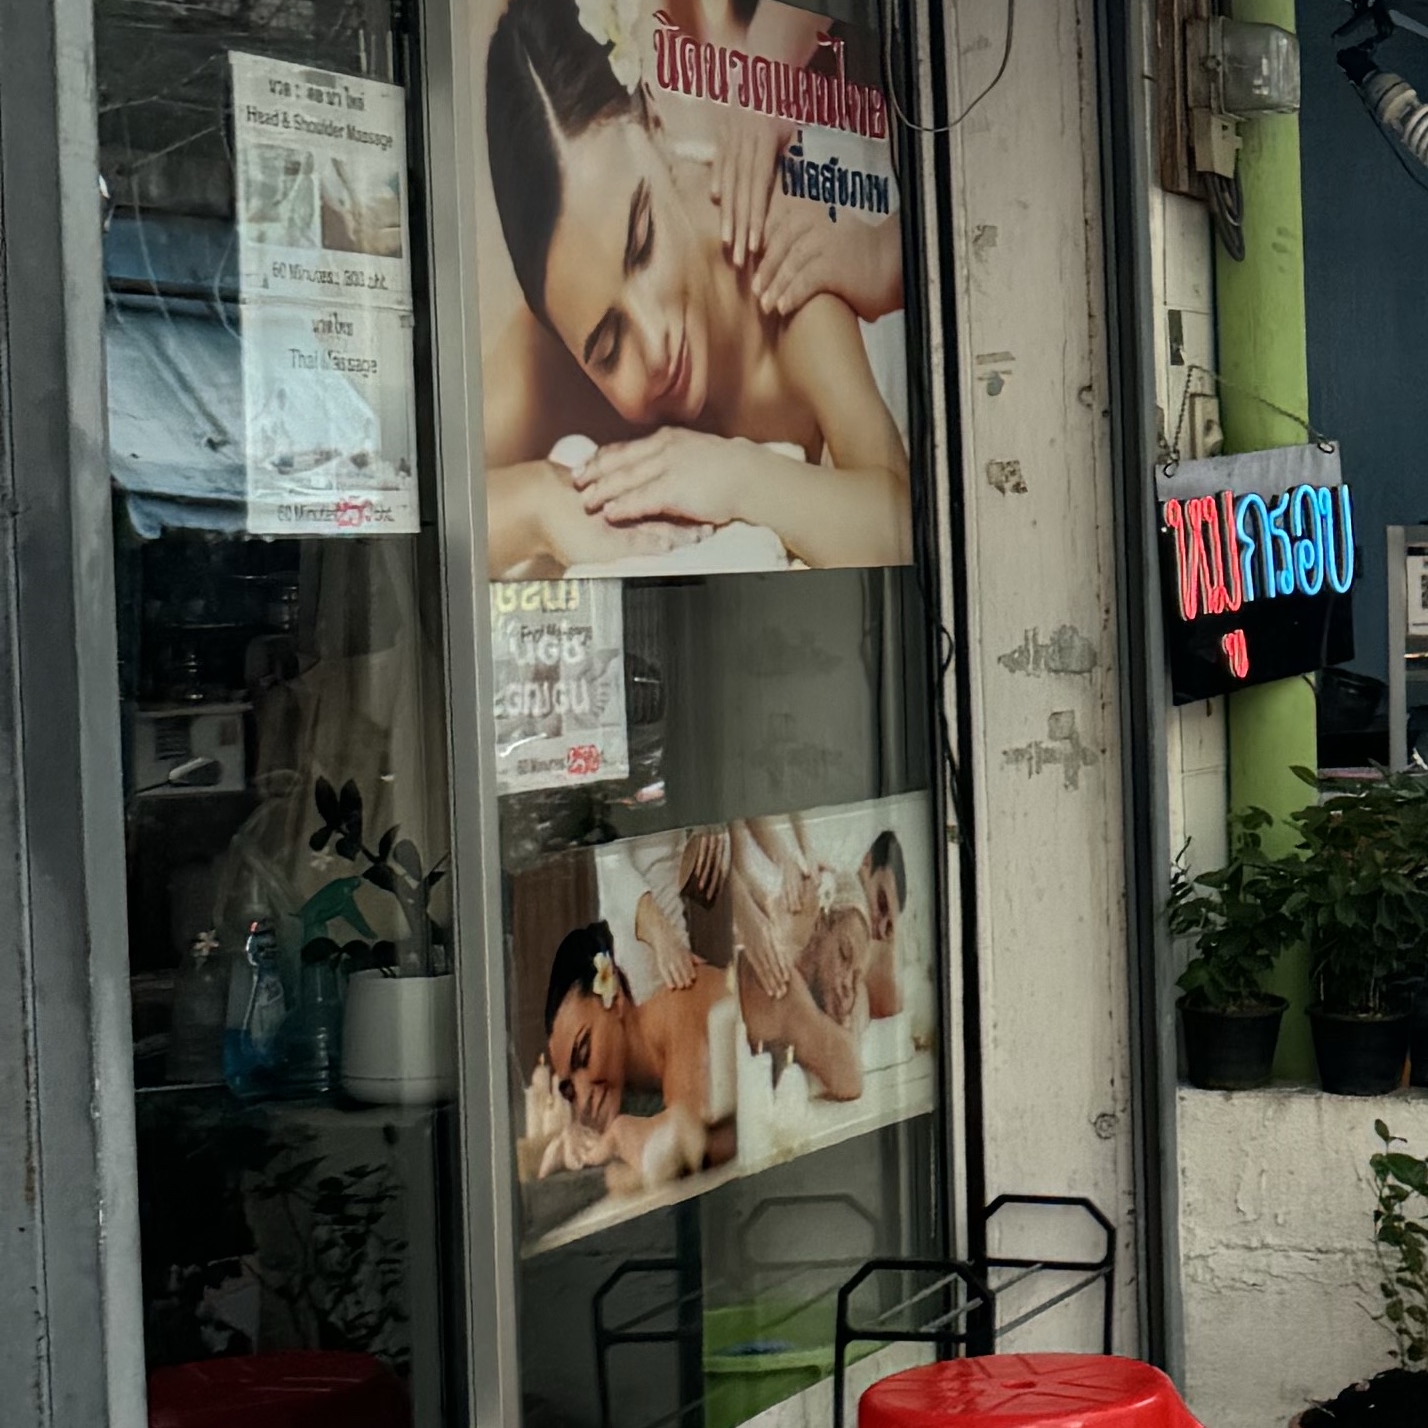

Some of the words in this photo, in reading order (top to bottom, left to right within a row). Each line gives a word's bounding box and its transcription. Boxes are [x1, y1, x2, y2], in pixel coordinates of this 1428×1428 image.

[246, 105, 279, 127] Head
[778, 130, 889, 222] เพื่อสุขภาพ
